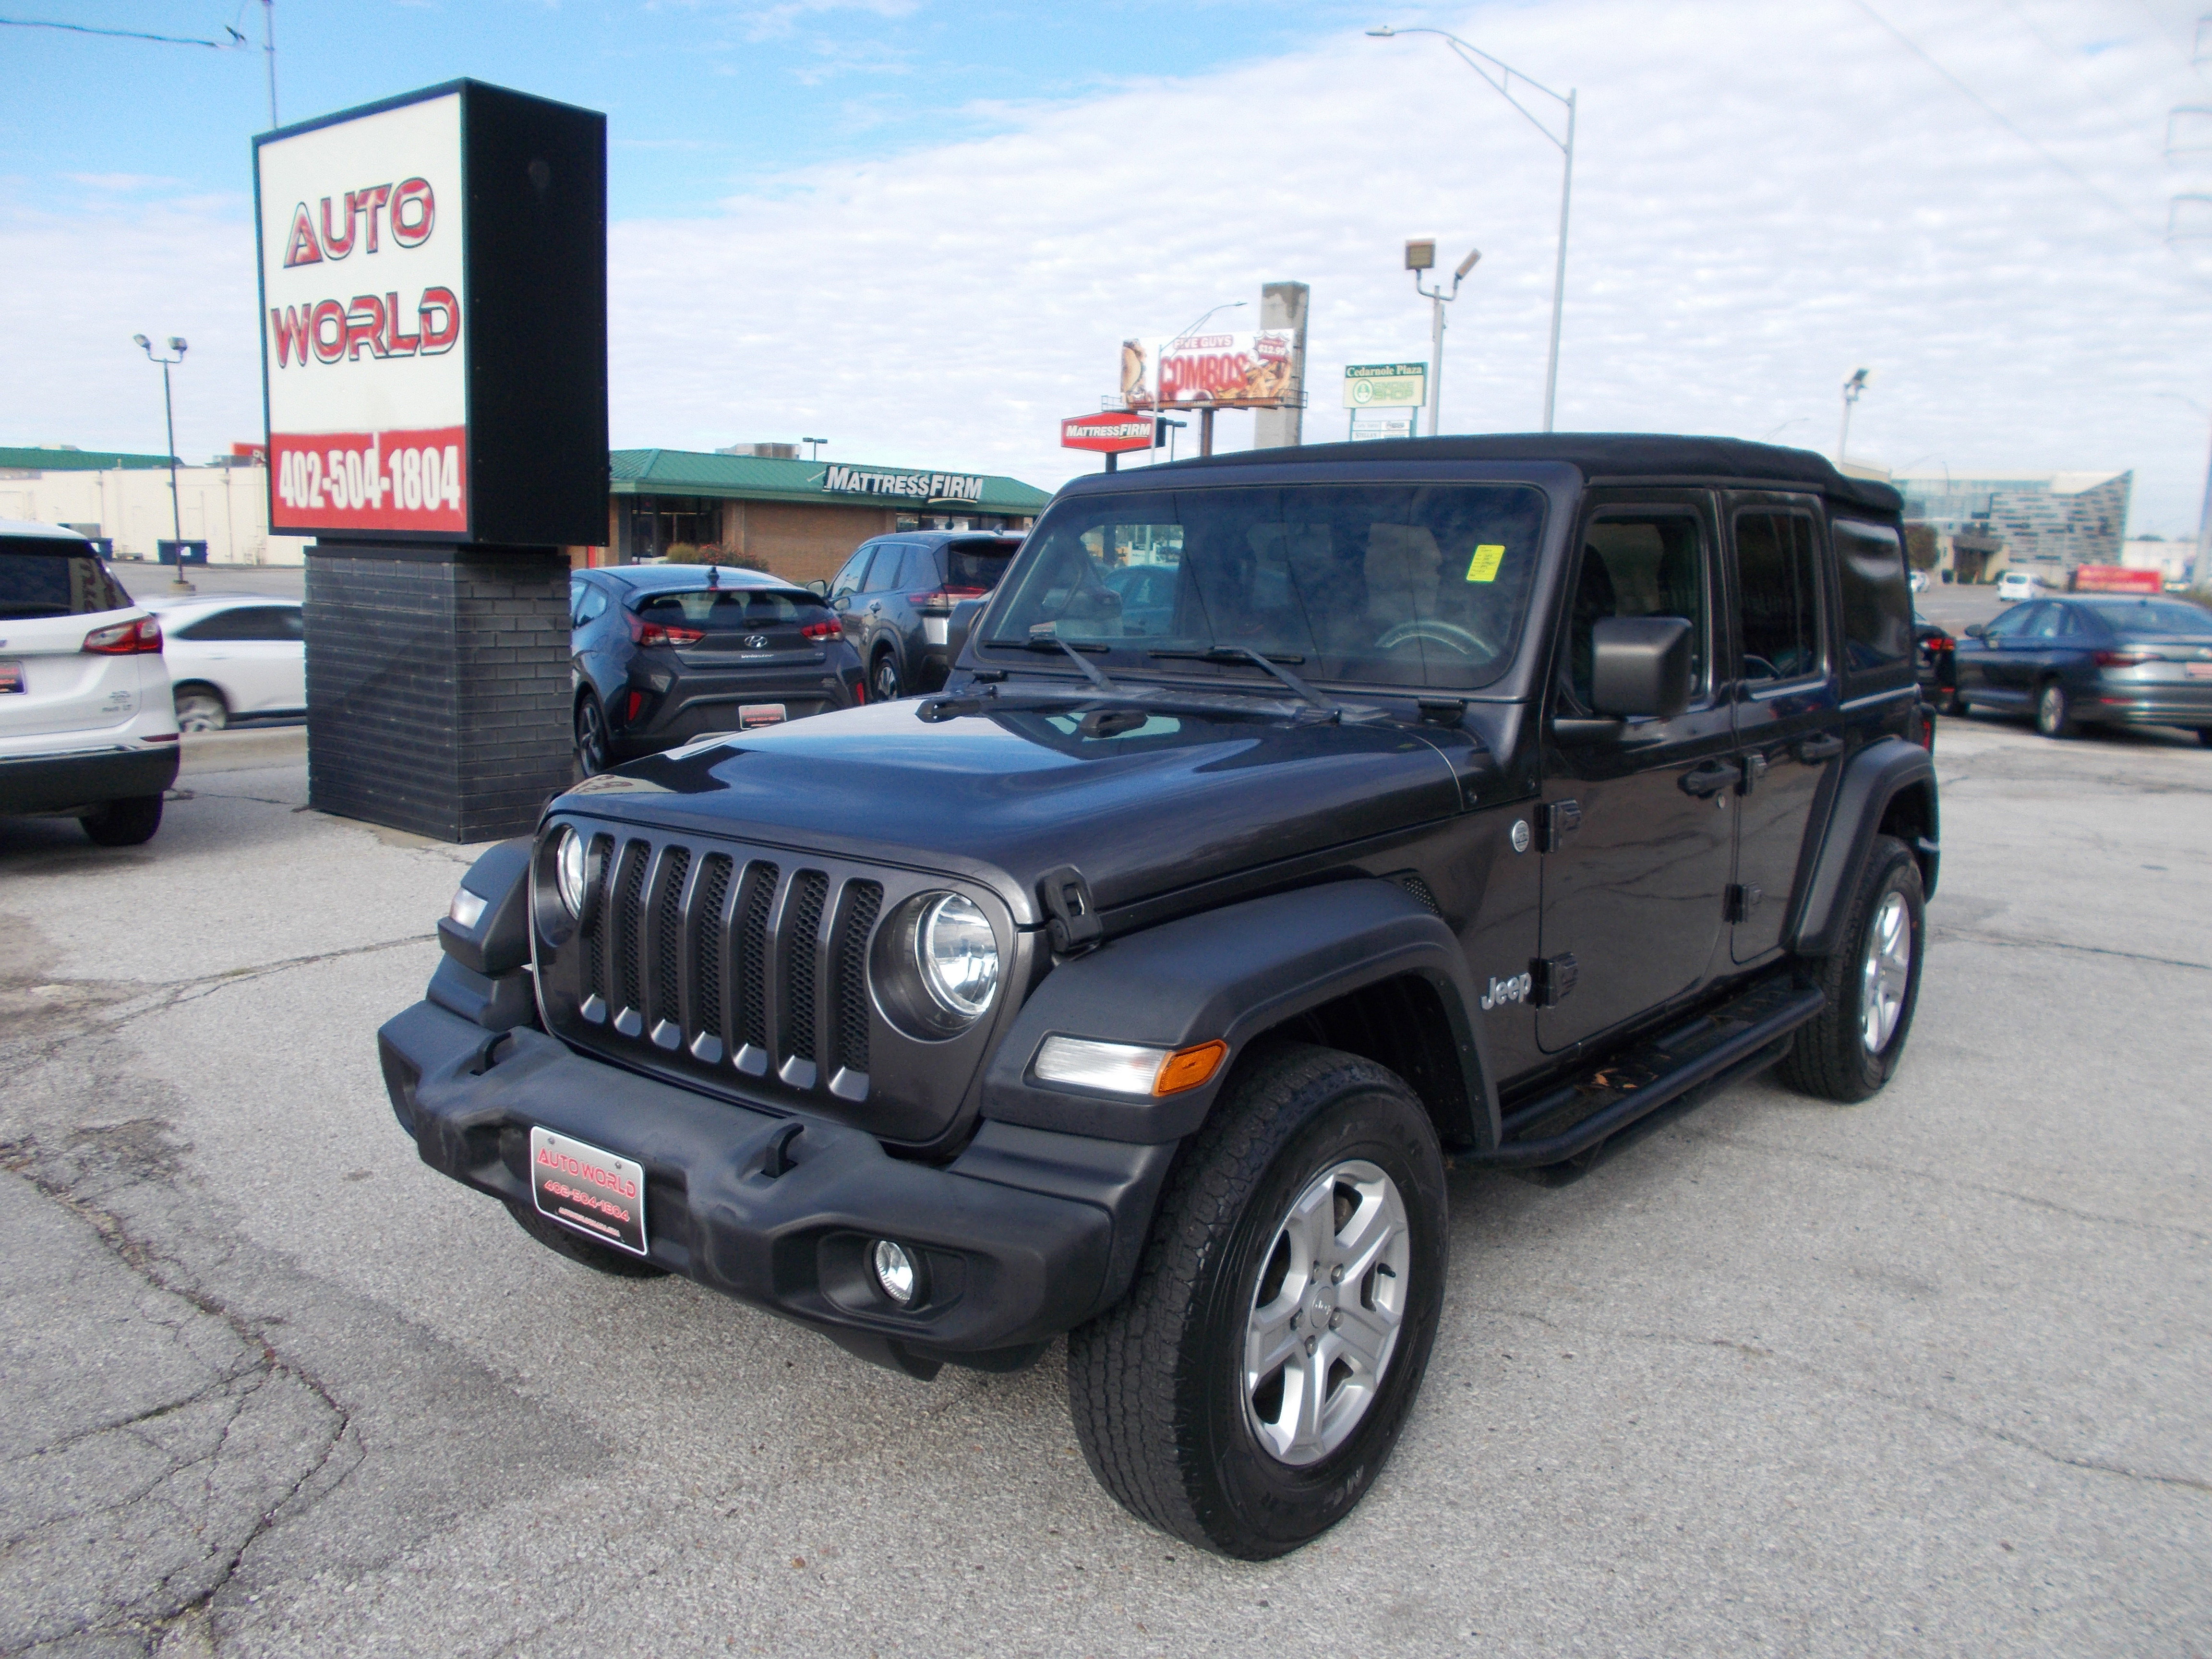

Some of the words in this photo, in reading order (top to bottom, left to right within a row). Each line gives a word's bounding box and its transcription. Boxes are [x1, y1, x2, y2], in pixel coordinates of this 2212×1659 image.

[283, 177, 435, 268] AUTO
[271, 286, 460, 369] WORLD
[1174, 337, 1198, 349] FIVE
[1200, 336, 1232, 347] GUYS
[1159, 352, 1250, 392] COMBOS
[1396, 364, 1422, 375] Plaza
[279, 445, 460, 510] 402-504-1804
[1481, 972, 1532, 1010] Jeep
[543, 1179, 631, 1223] 402-504-1804
